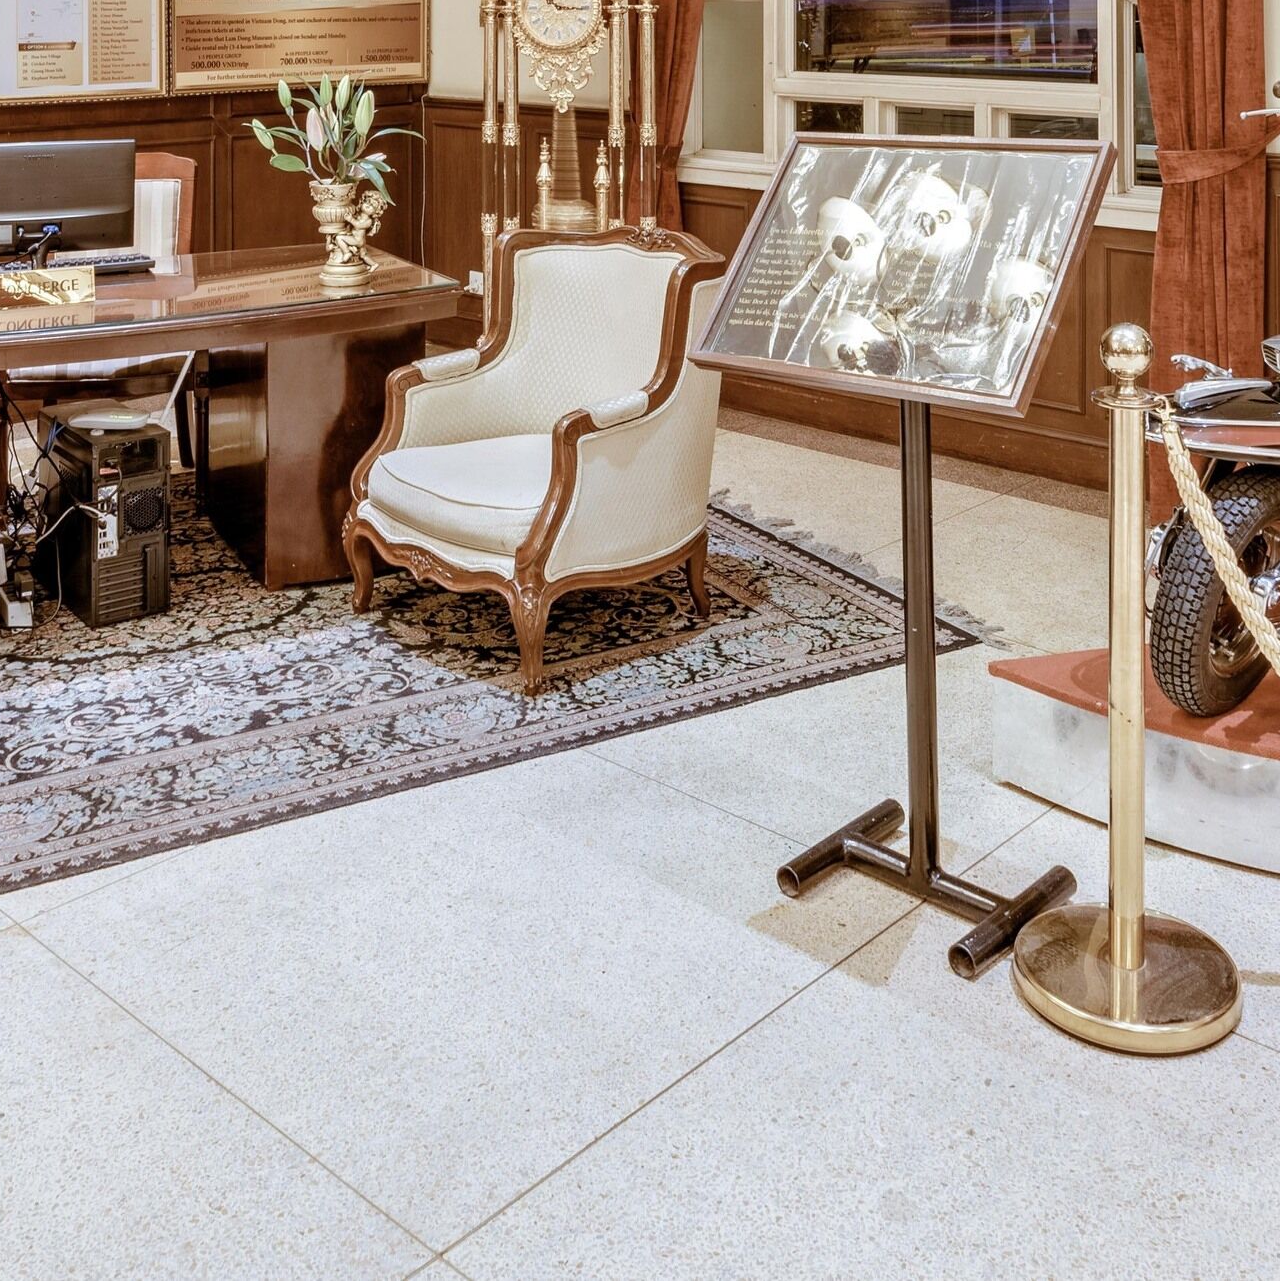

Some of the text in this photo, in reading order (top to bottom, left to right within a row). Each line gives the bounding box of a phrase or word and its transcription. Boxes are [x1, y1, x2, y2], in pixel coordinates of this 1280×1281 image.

[280, 57, 308, 65] 700.000
[360, 53, 392, 64] 1.500.000
[191, 61, 249, 70] 500.000 VND/trip
